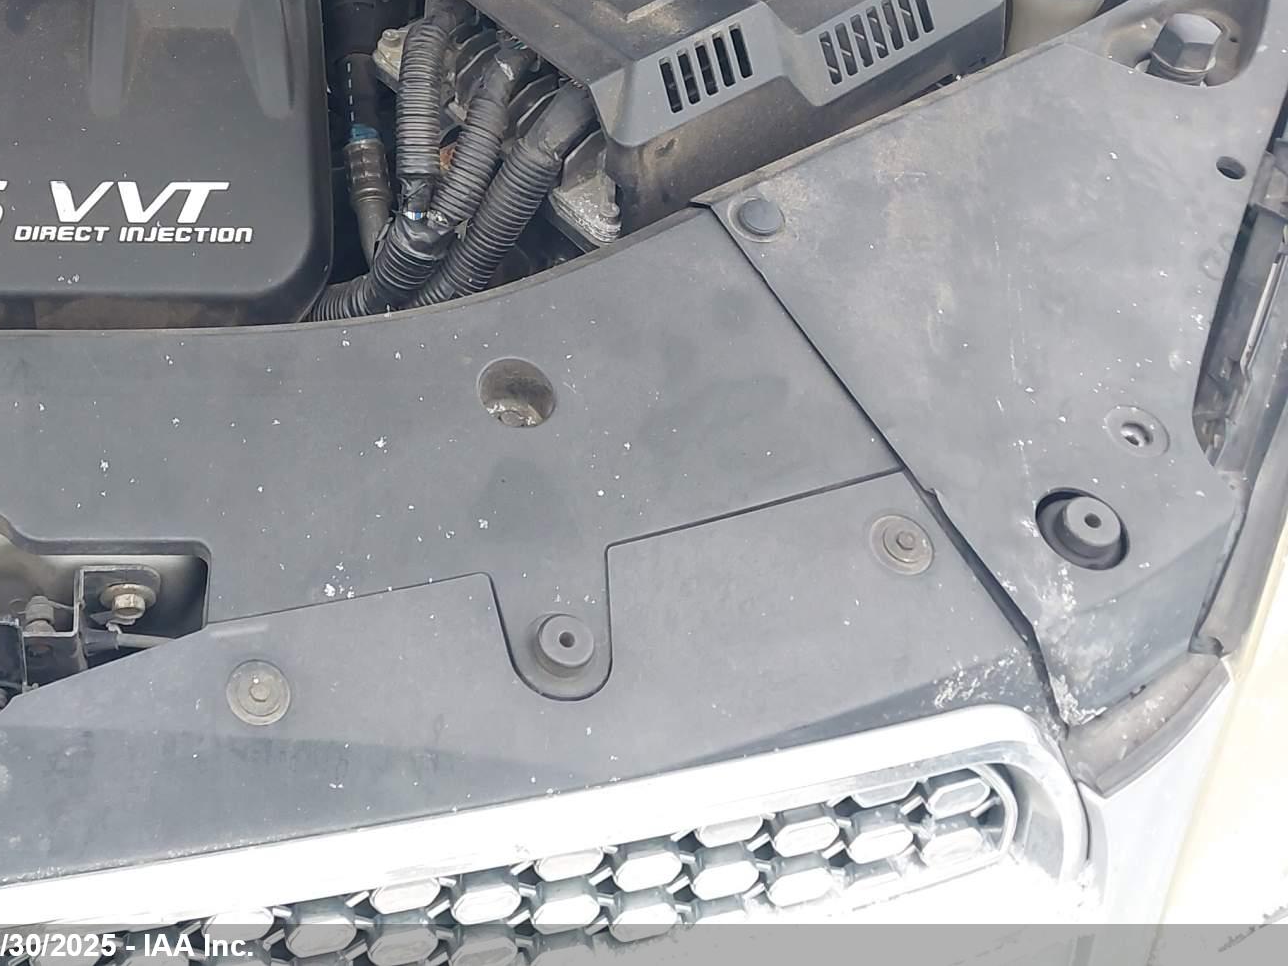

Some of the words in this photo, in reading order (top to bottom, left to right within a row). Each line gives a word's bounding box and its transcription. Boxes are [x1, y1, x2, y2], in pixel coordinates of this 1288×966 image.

[50, 180, 230, 224] VVT
[14, 225, 111, 242] DIRECT
[118, 226, 254, 244] INJECTION
